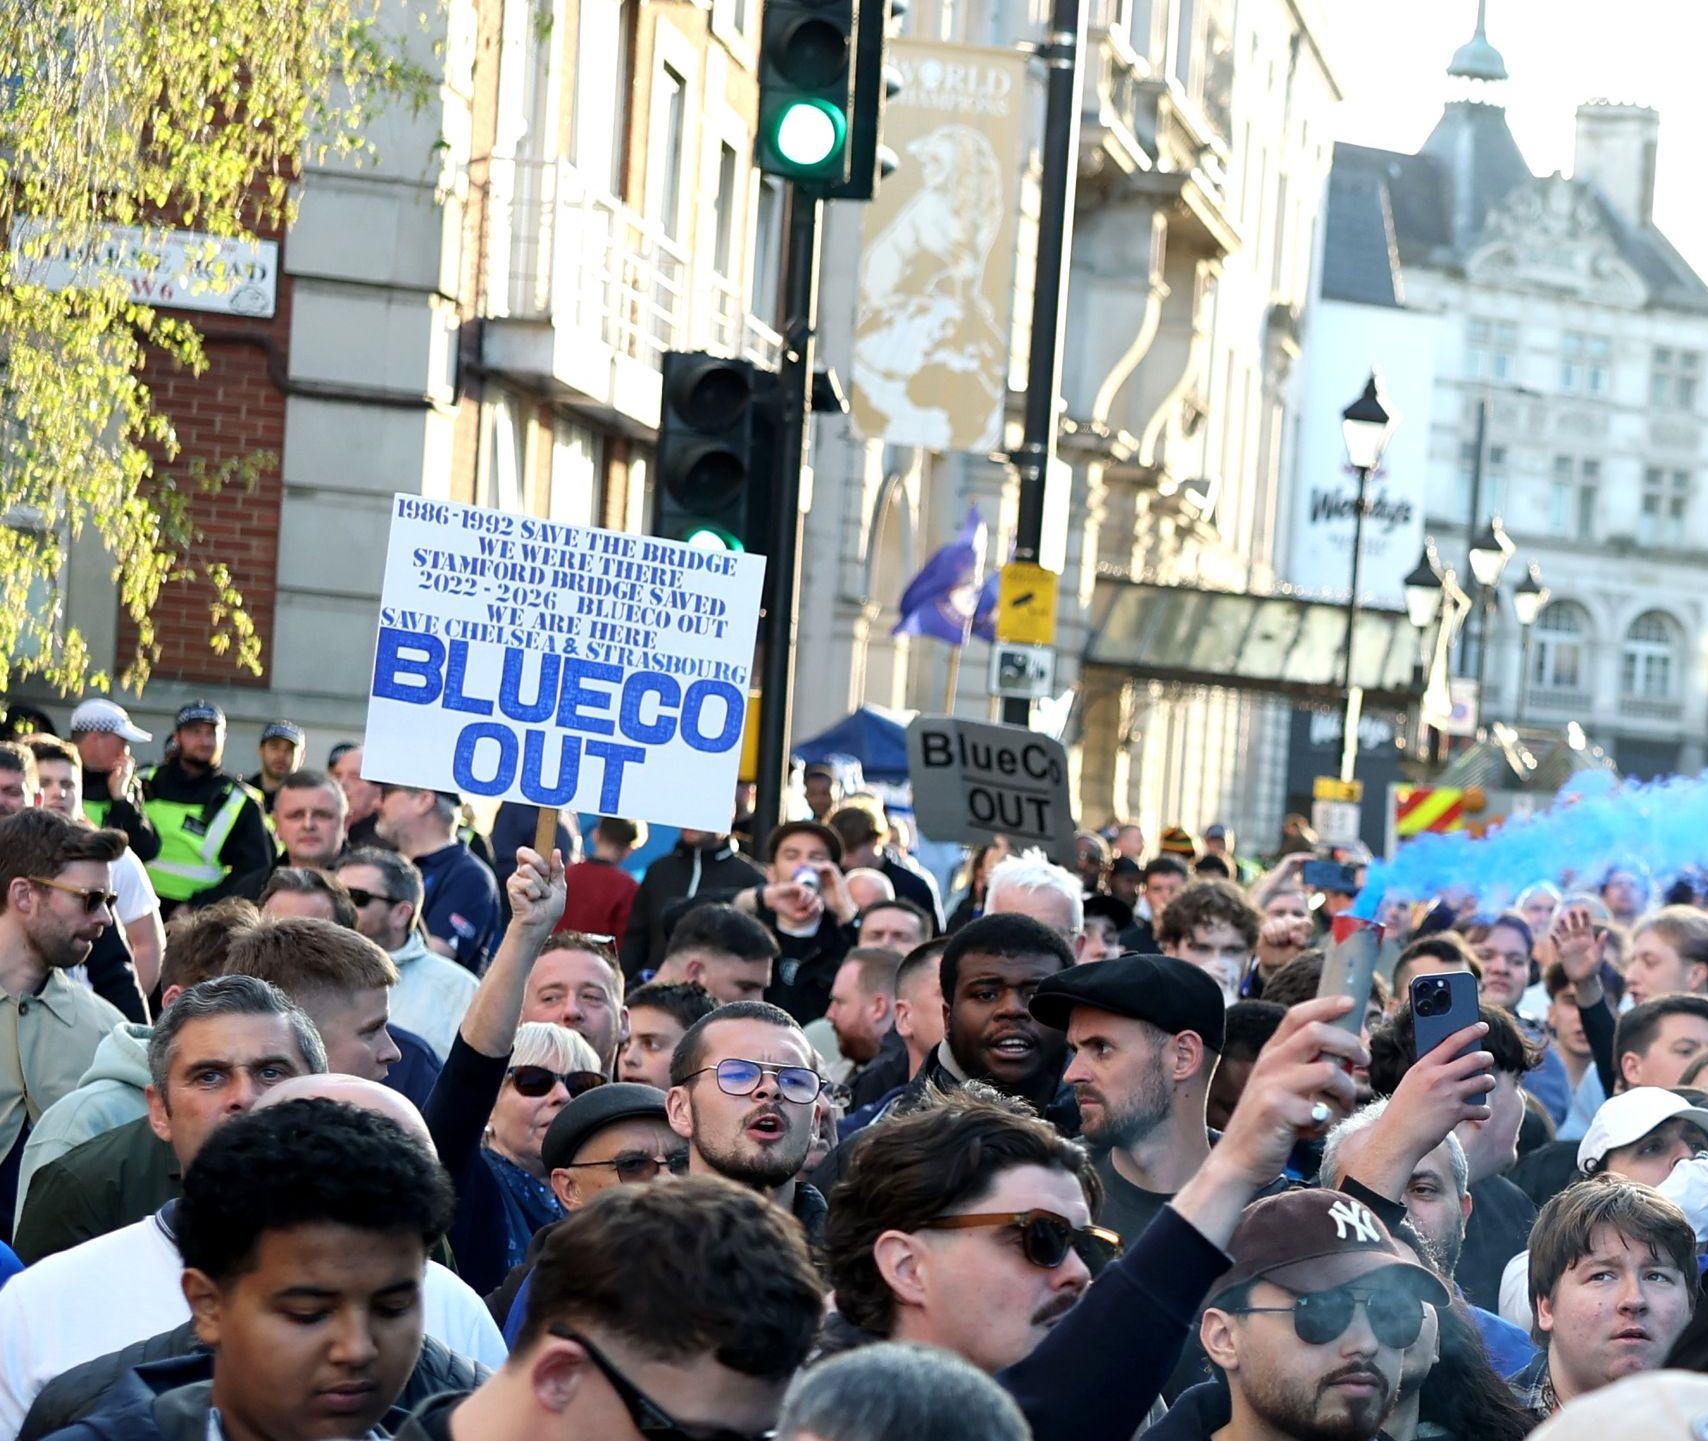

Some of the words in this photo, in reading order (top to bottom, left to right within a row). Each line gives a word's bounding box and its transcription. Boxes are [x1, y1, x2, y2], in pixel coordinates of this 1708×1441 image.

[479, 536, 515, 560] WE
[521, 543, 594, 571] WERE
[599, 556, 685, 590] THERE
[520, 521, 580, 550] SAVE
[587, 532, 636, 561] THE
[643, 542, 738, 577] BRIDGE
[413, 547, 546, 586] STAMFORD
[552, 569, 644, 603] BRIDGE
[649, 588, 727, 618] SAVED
[418, 569, 479, 597] 2022
[497, 584, 558, 612] 2026
[577, 595, 672, 630] BLUECO
[677, 614, 729, 640] OUT
[381, 607, 440, 635] SAVE
[445, 618, 557, 654] CHELSEA
[562, 636, 579, 656] &
[586, 642, 748, 685] STRASBOURG
[487, 604, 524, 628] WE
[531, 611, 582, 637] ARE
[590, 620, 658, 651] HERE
[372, 626, 746, 753] BLUECO
[453, 721, 647, 815] OUT
[921, 731, 1063, 787] BlueCo
[968, 787, 1051, 834] OUT
[1328, 1200, 1381, 1243] NY
